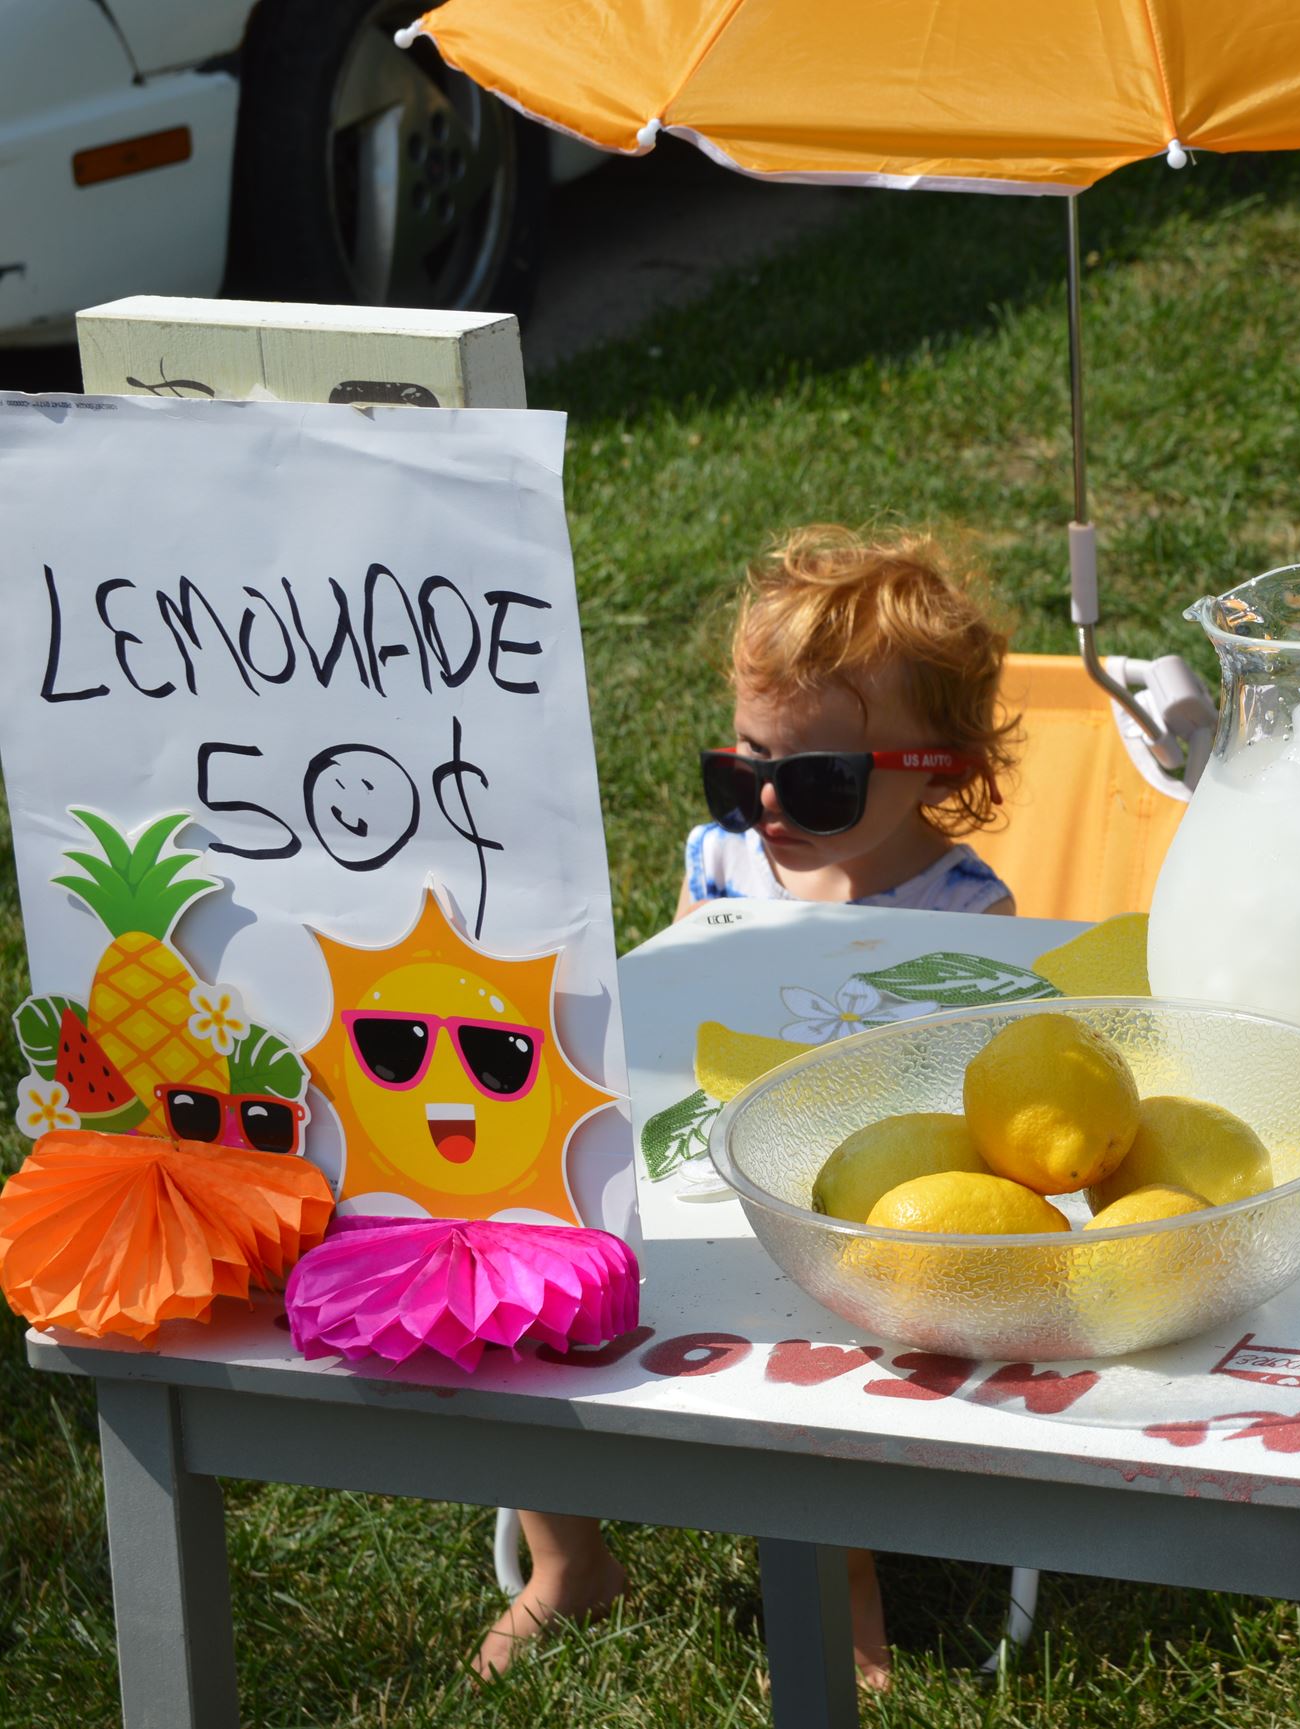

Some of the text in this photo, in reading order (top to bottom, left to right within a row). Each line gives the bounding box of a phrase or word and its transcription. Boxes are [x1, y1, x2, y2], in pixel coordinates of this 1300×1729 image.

[40, 564, 552, 703] LEMONADE
[903, 754, 952, 767] US AUTO
